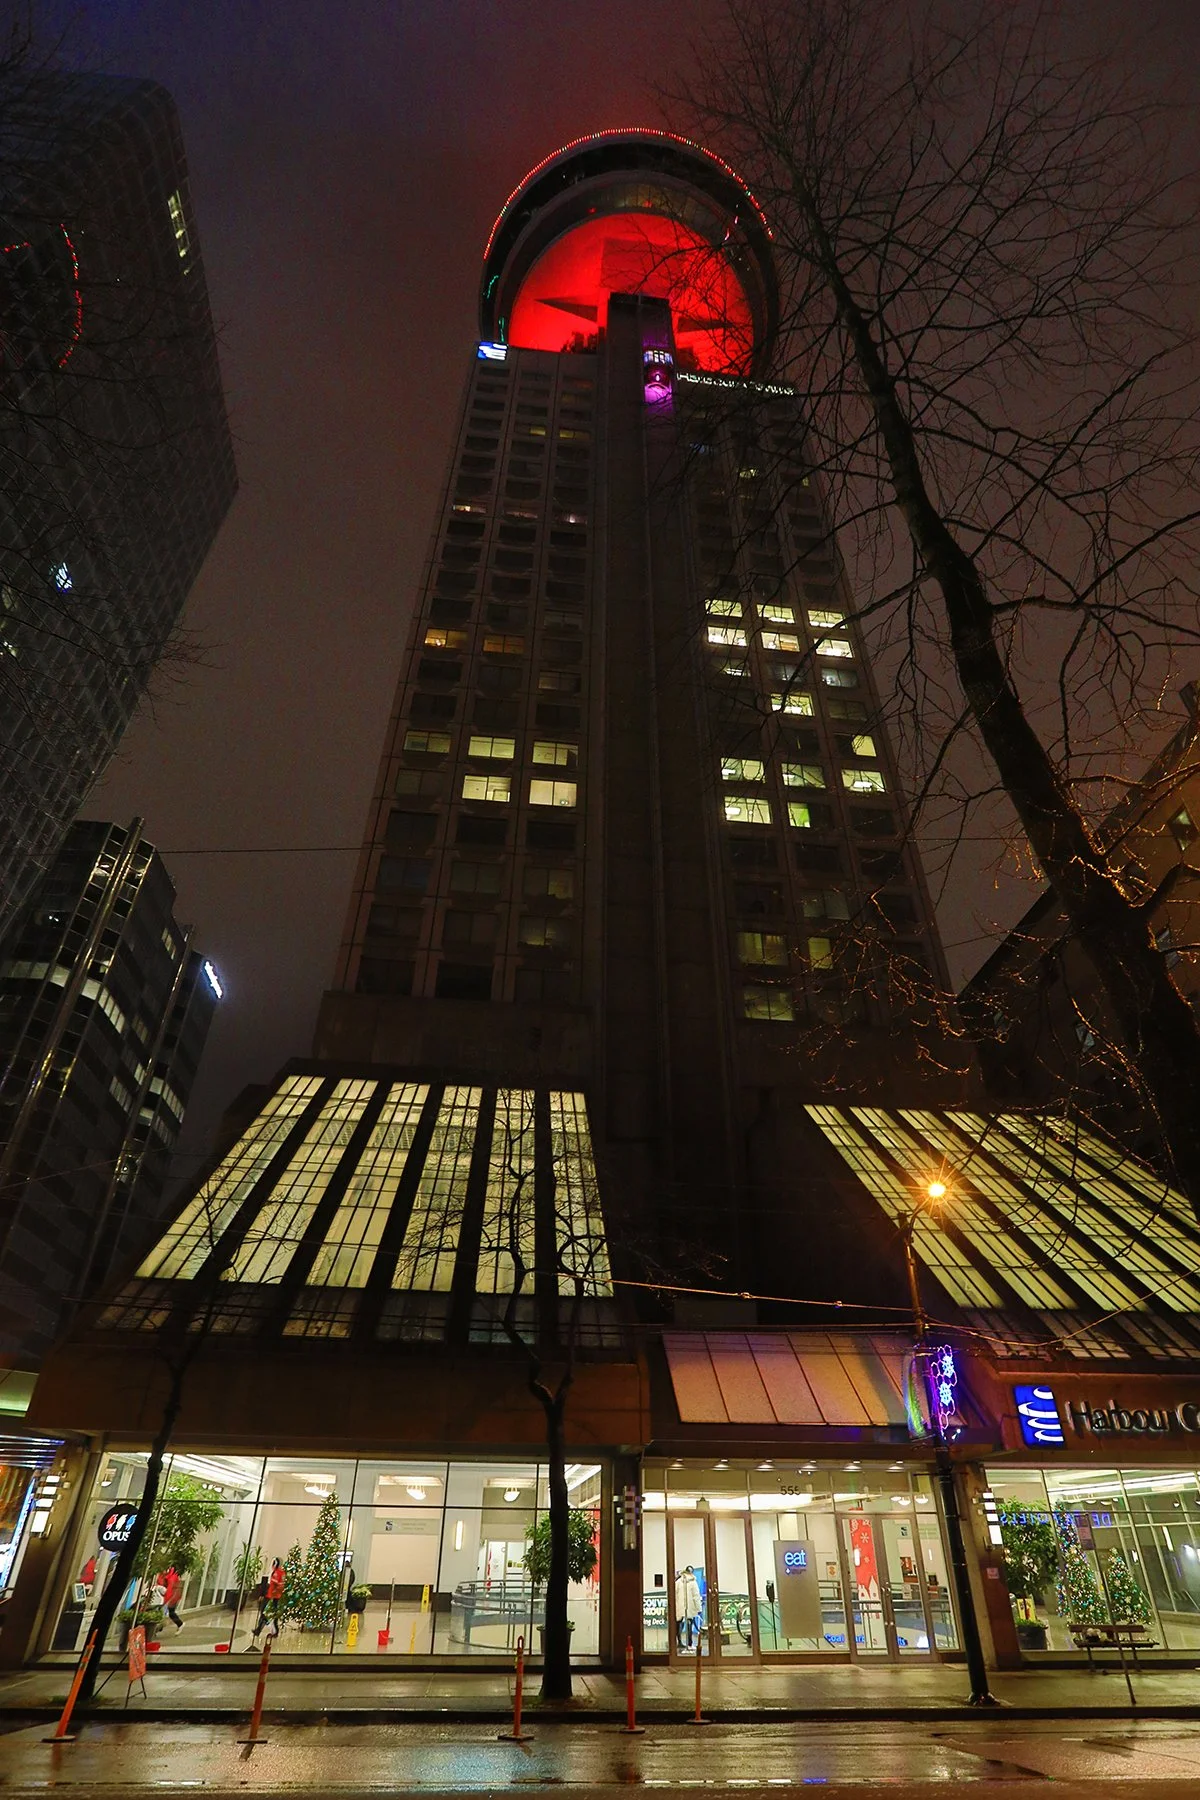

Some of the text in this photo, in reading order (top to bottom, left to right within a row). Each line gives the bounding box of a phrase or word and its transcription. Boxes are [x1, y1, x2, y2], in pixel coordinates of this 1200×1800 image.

[780, 1485, 800, 1496] 555
[102, 1530, 131, 1542] OPUS
[784, 1549, 807, 1566] eat
[824, 1632, 846, 1643] Coal
